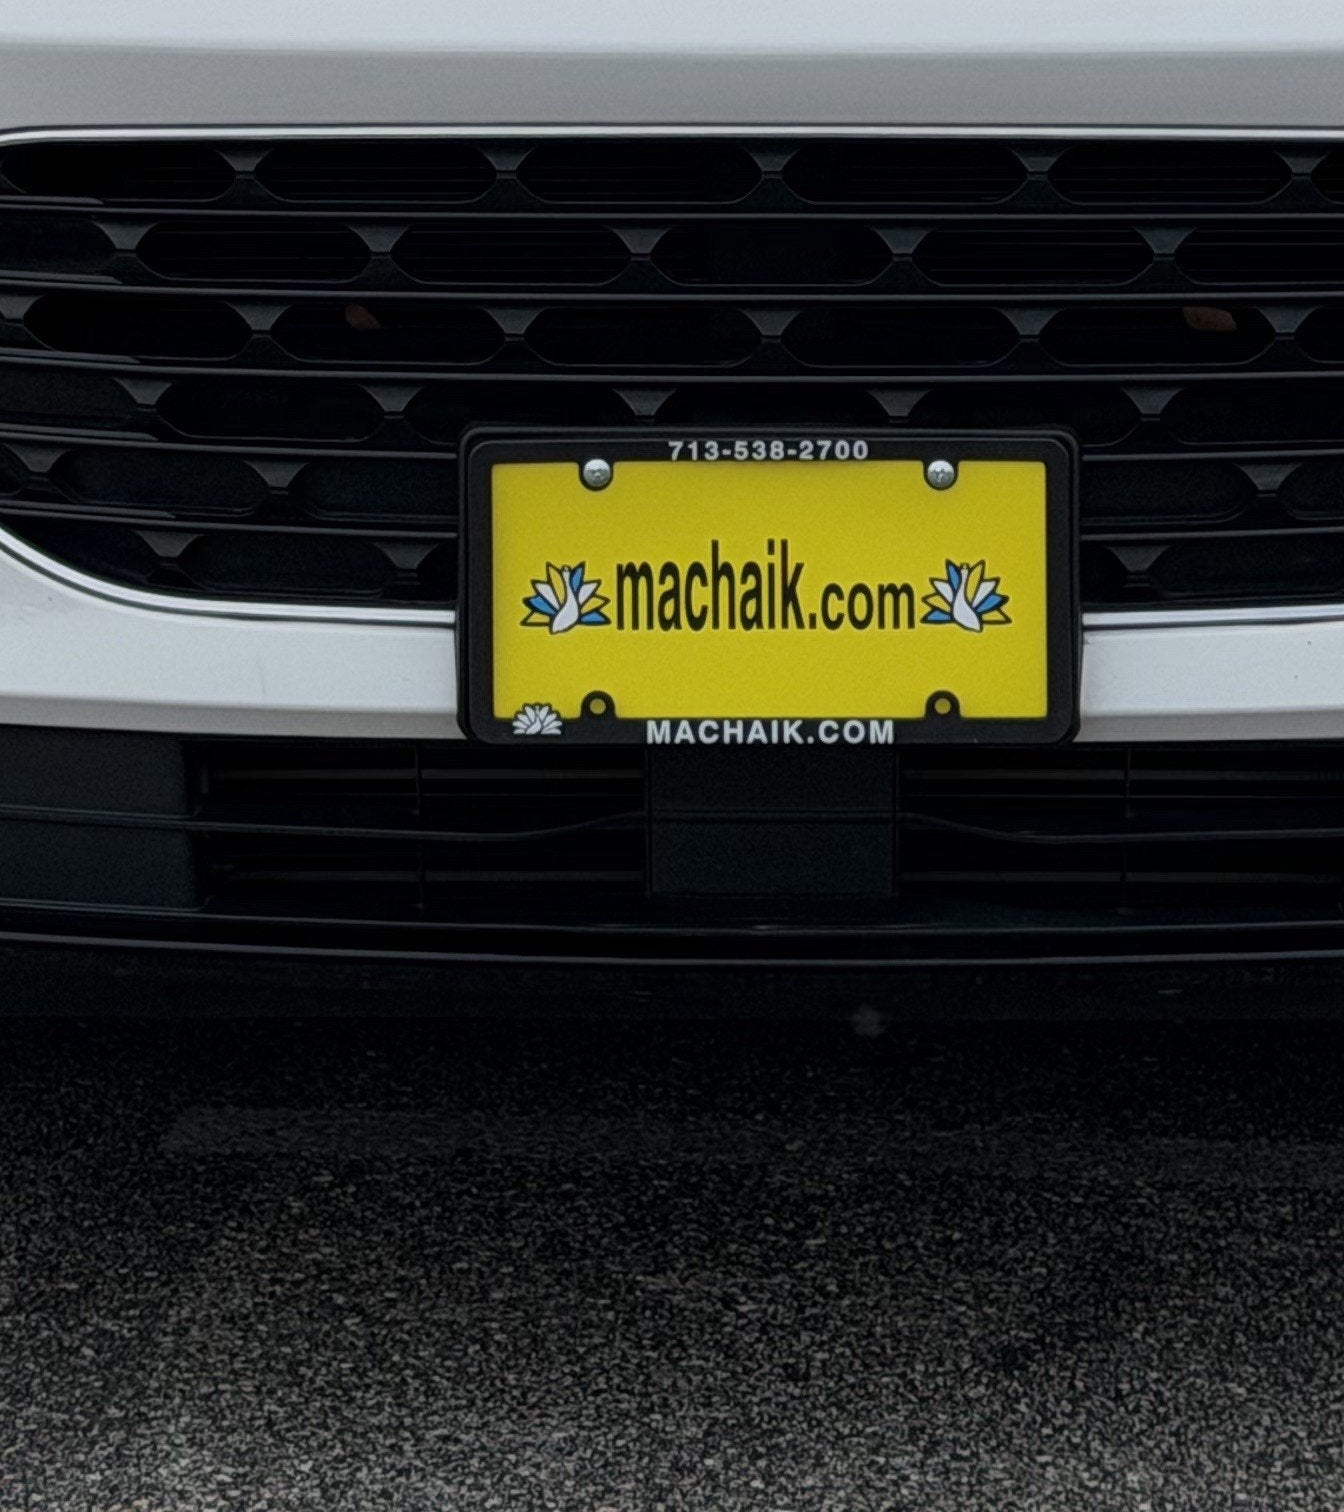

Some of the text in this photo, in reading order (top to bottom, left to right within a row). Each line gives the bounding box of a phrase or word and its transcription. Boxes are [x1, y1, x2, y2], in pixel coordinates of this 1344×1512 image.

[668, 440, 870, 461] 713-538-2700
[616, 539, 916, 631] machaik.com
[647, 720, 895, 745] MACHAIK.COM
